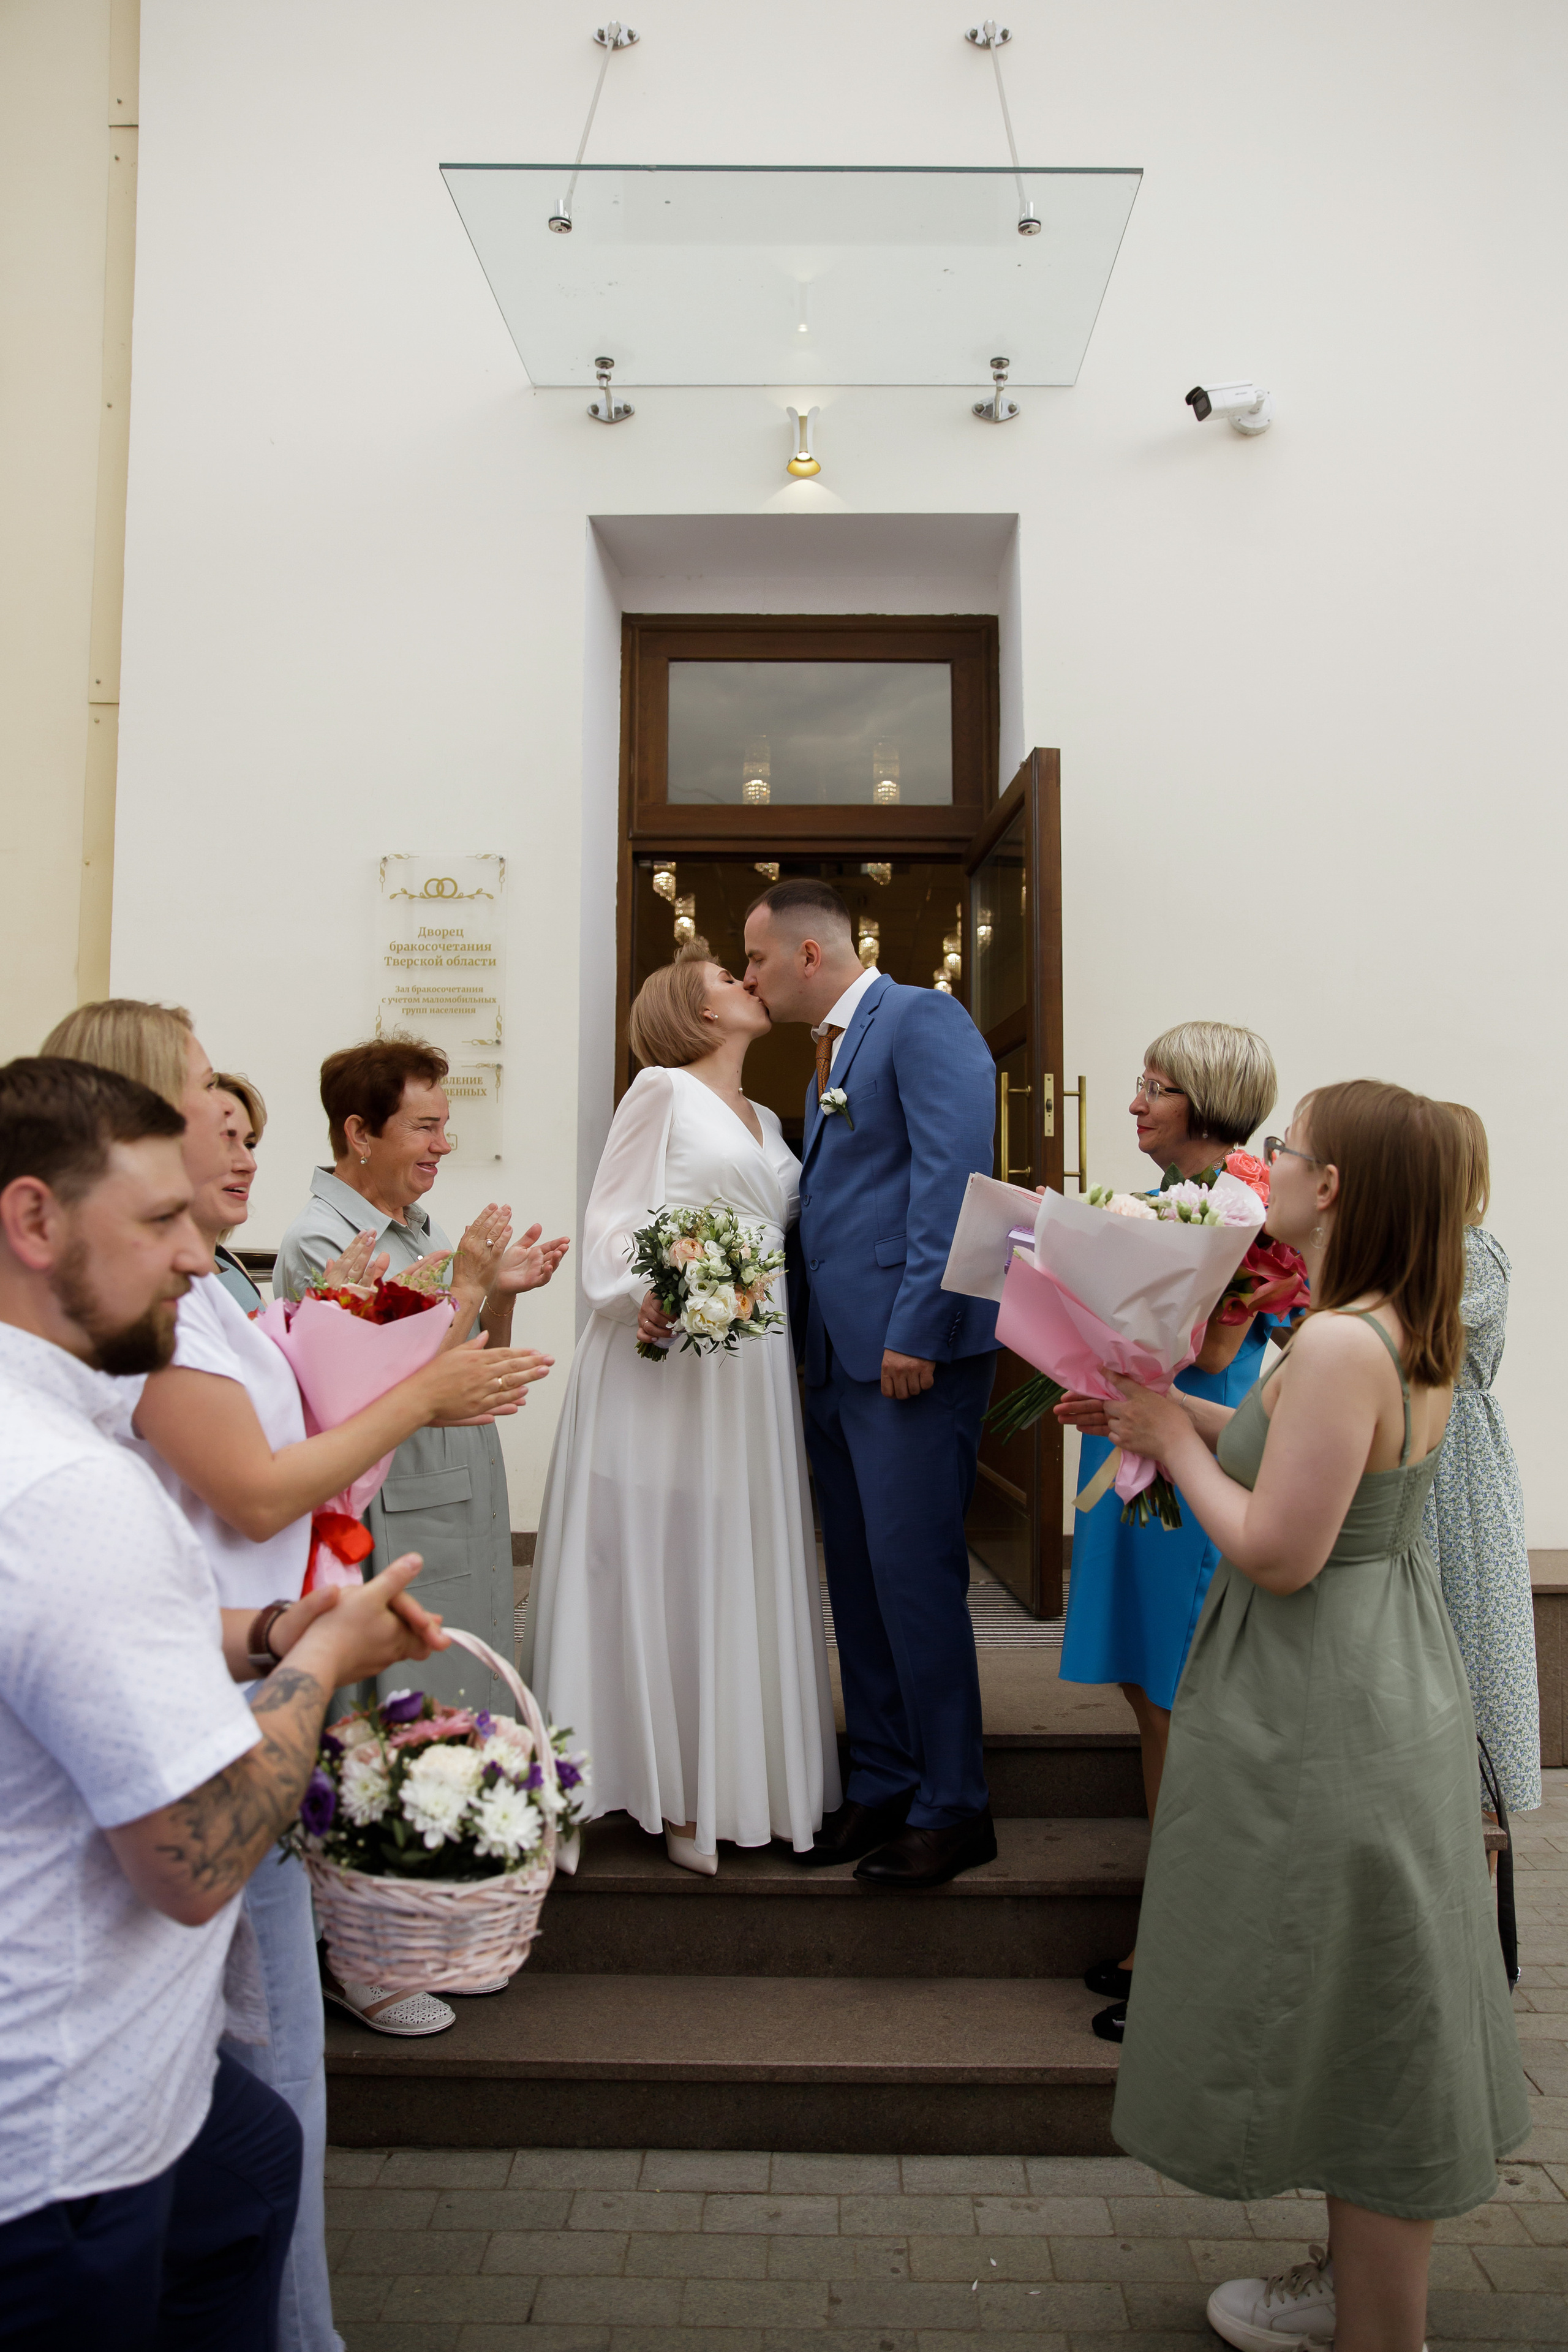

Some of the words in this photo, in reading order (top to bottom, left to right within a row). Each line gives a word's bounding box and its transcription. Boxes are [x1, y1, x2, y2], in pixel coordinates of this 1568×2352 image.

[418, 927, 464, 939] Дворец
[390, 941, 492, 954] бракосочетания
[384, 956, 443, 968] Тверской
[447, 956, 496, 967] области
[412, 985, 483, 994] бракосочетания
